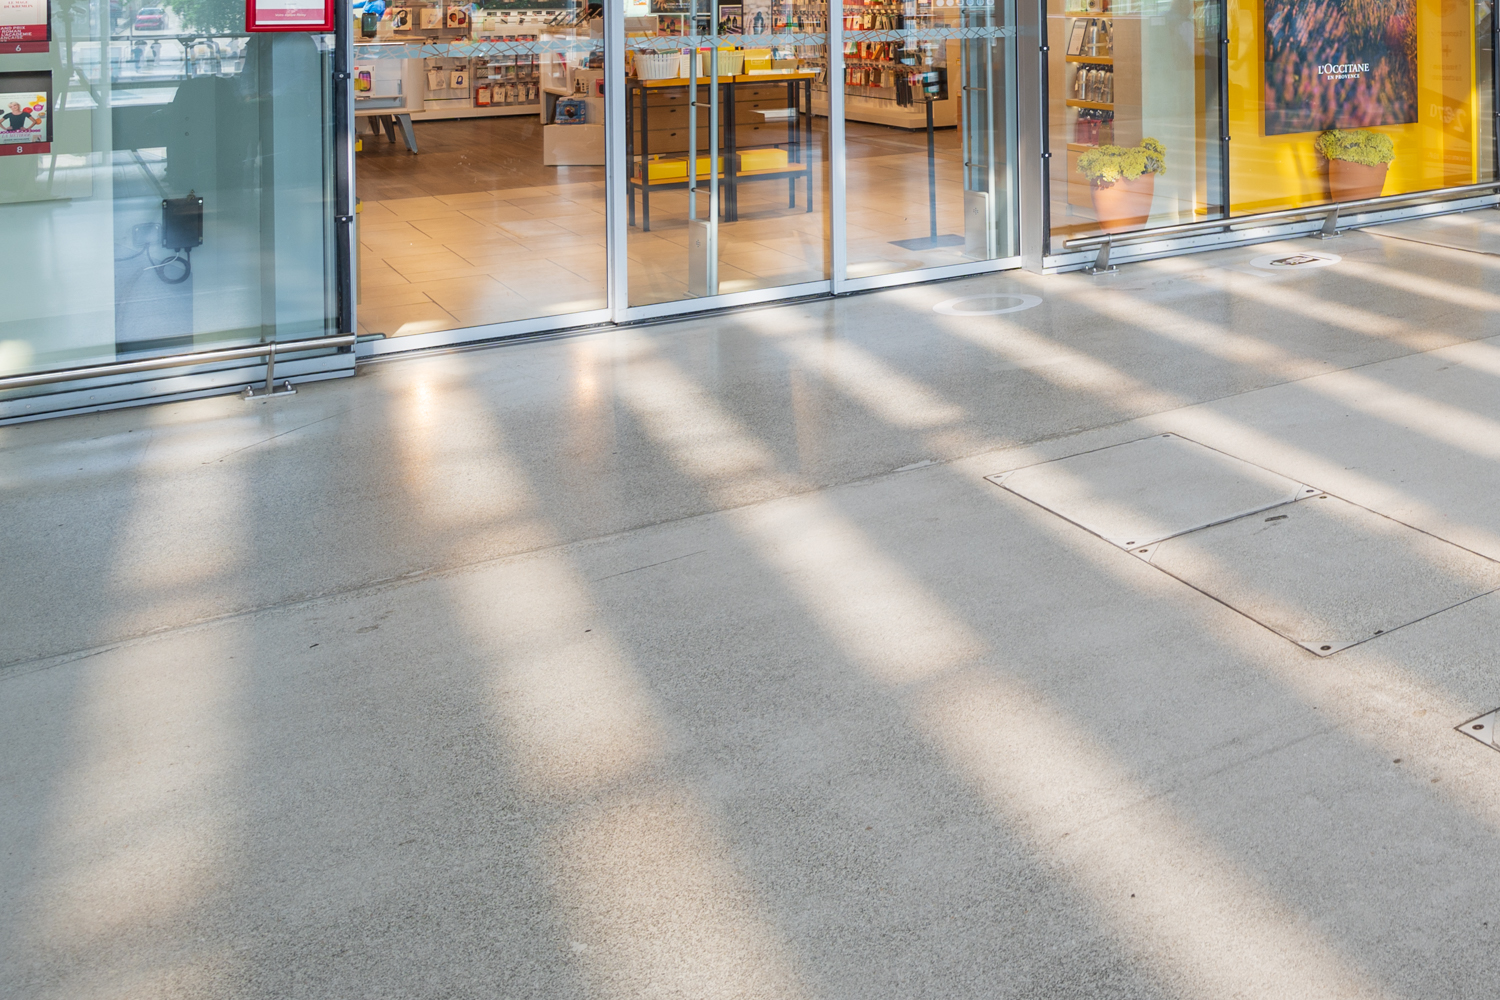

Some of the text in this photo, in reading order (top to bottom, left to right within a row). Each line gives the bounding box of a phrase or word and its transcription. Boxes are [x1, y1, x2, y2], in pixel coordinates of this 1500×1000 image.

[15, 44, 22, 52] 6
[1318, 63, 1370, 75] L'OCCITANE
[16, 145, 23, 154] 8
